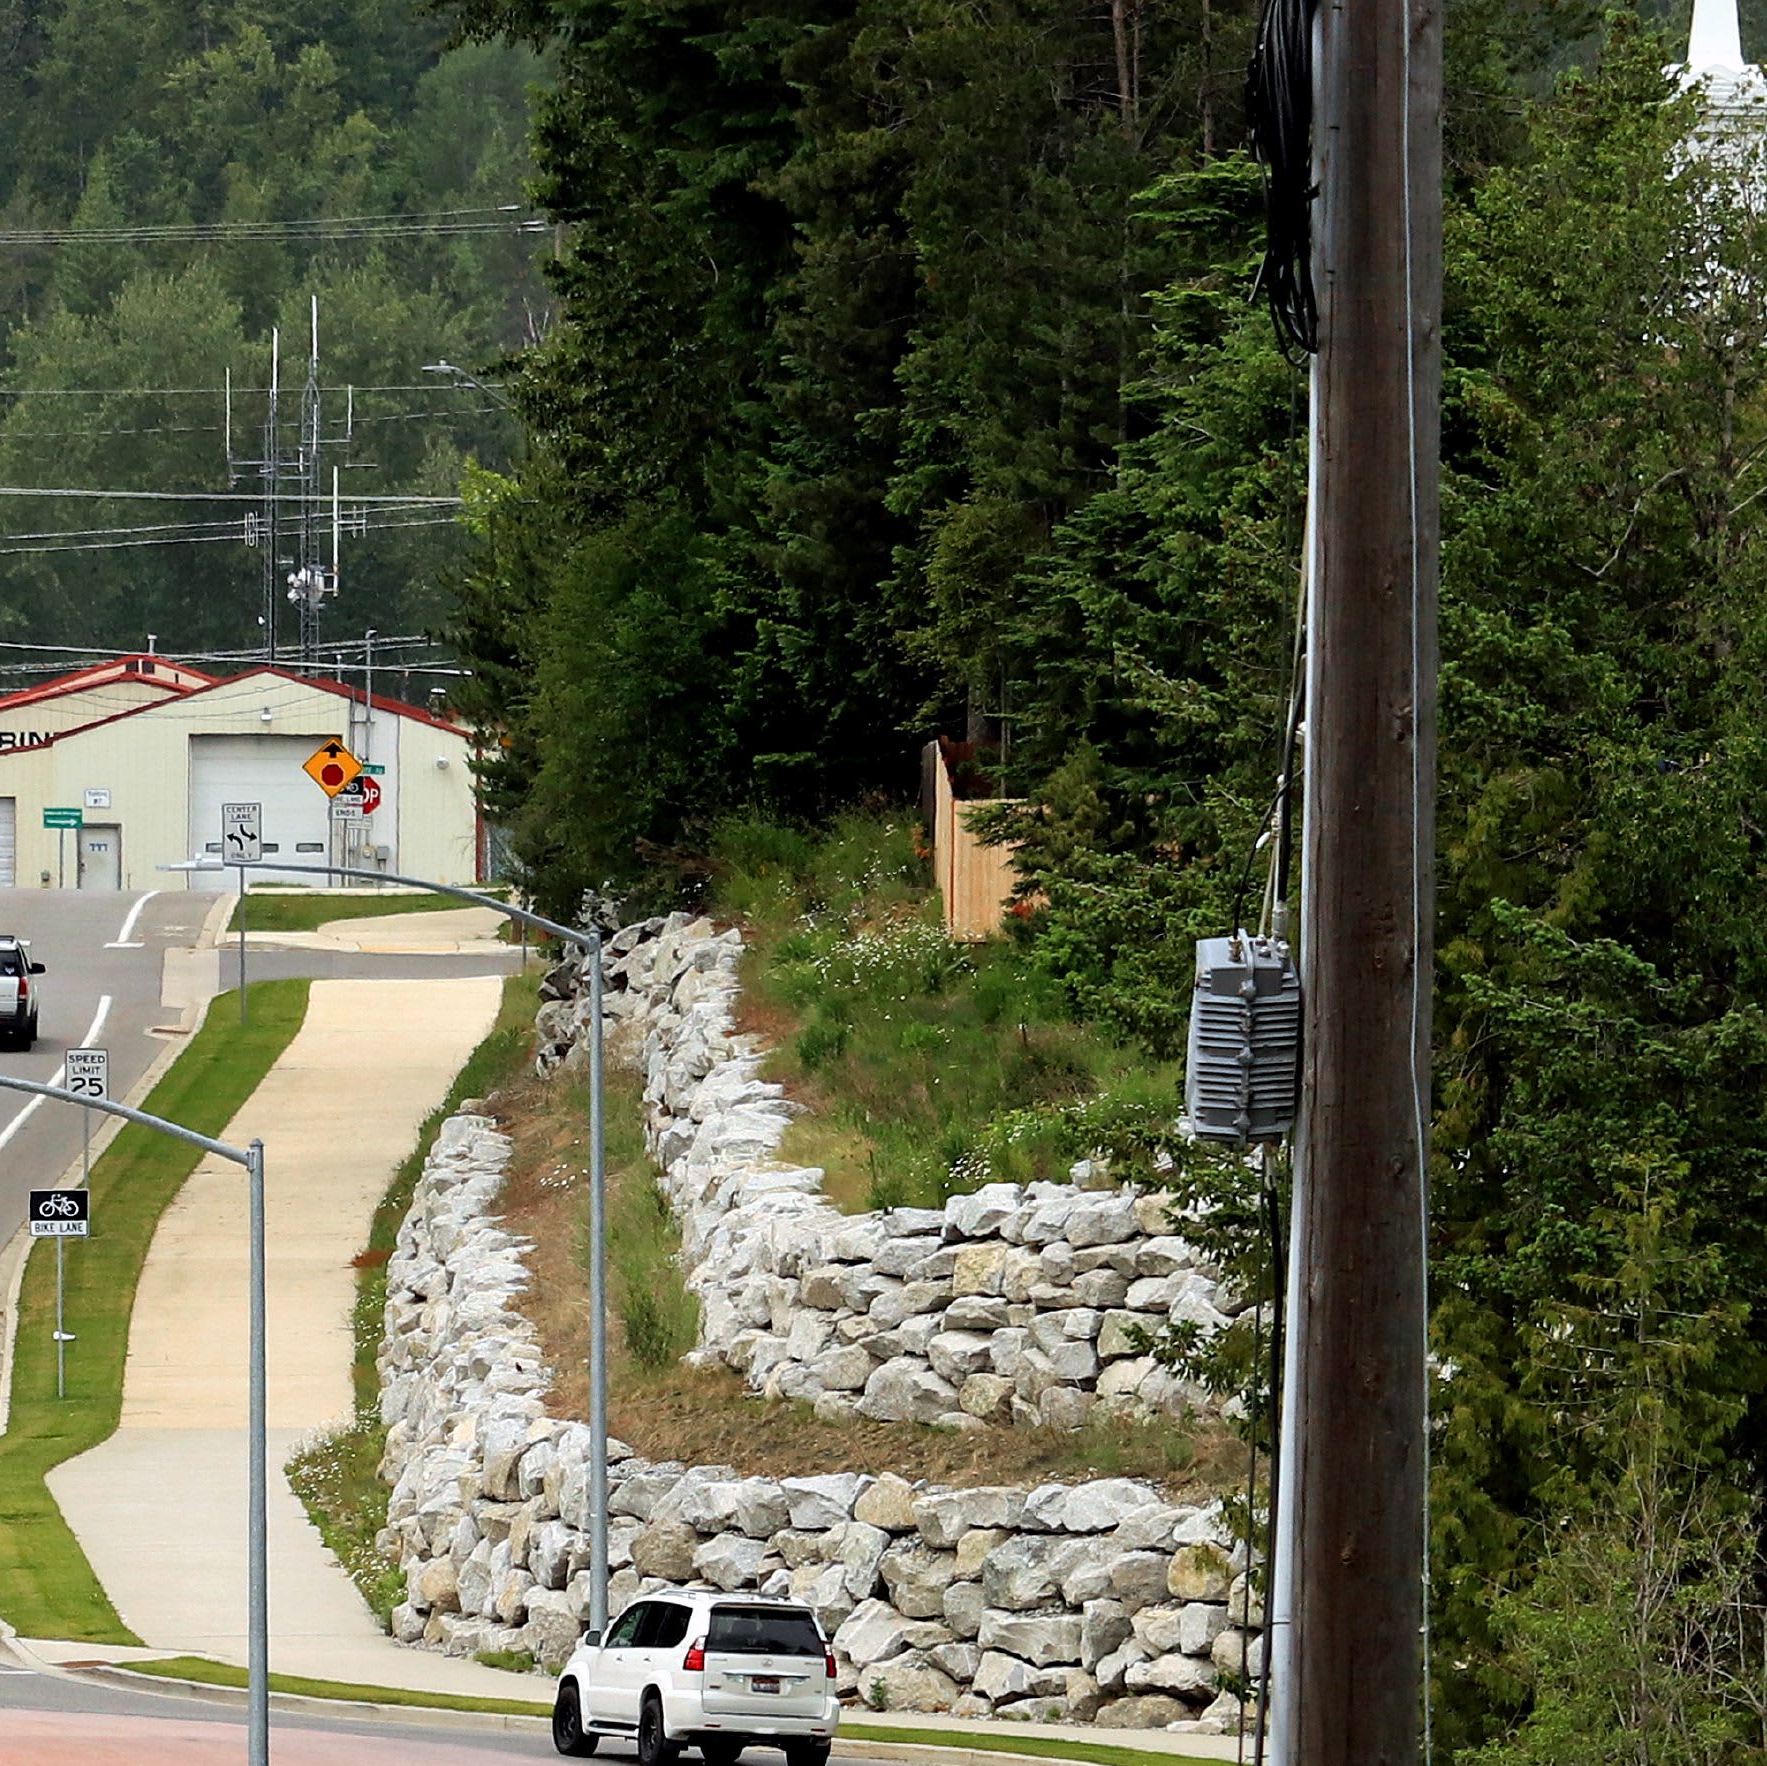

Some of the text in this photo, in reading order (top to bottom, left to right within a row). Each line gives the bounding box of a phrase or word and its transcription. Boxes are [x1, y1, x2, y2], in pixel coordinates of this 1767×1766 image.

[69, 1055, 106, 1064] SPEED
[72, 1066, 101, 1075] LIMIT
[71, 1077, 104, 1097] 25
[34, 1222, 84, 1233] BIKE LANE
